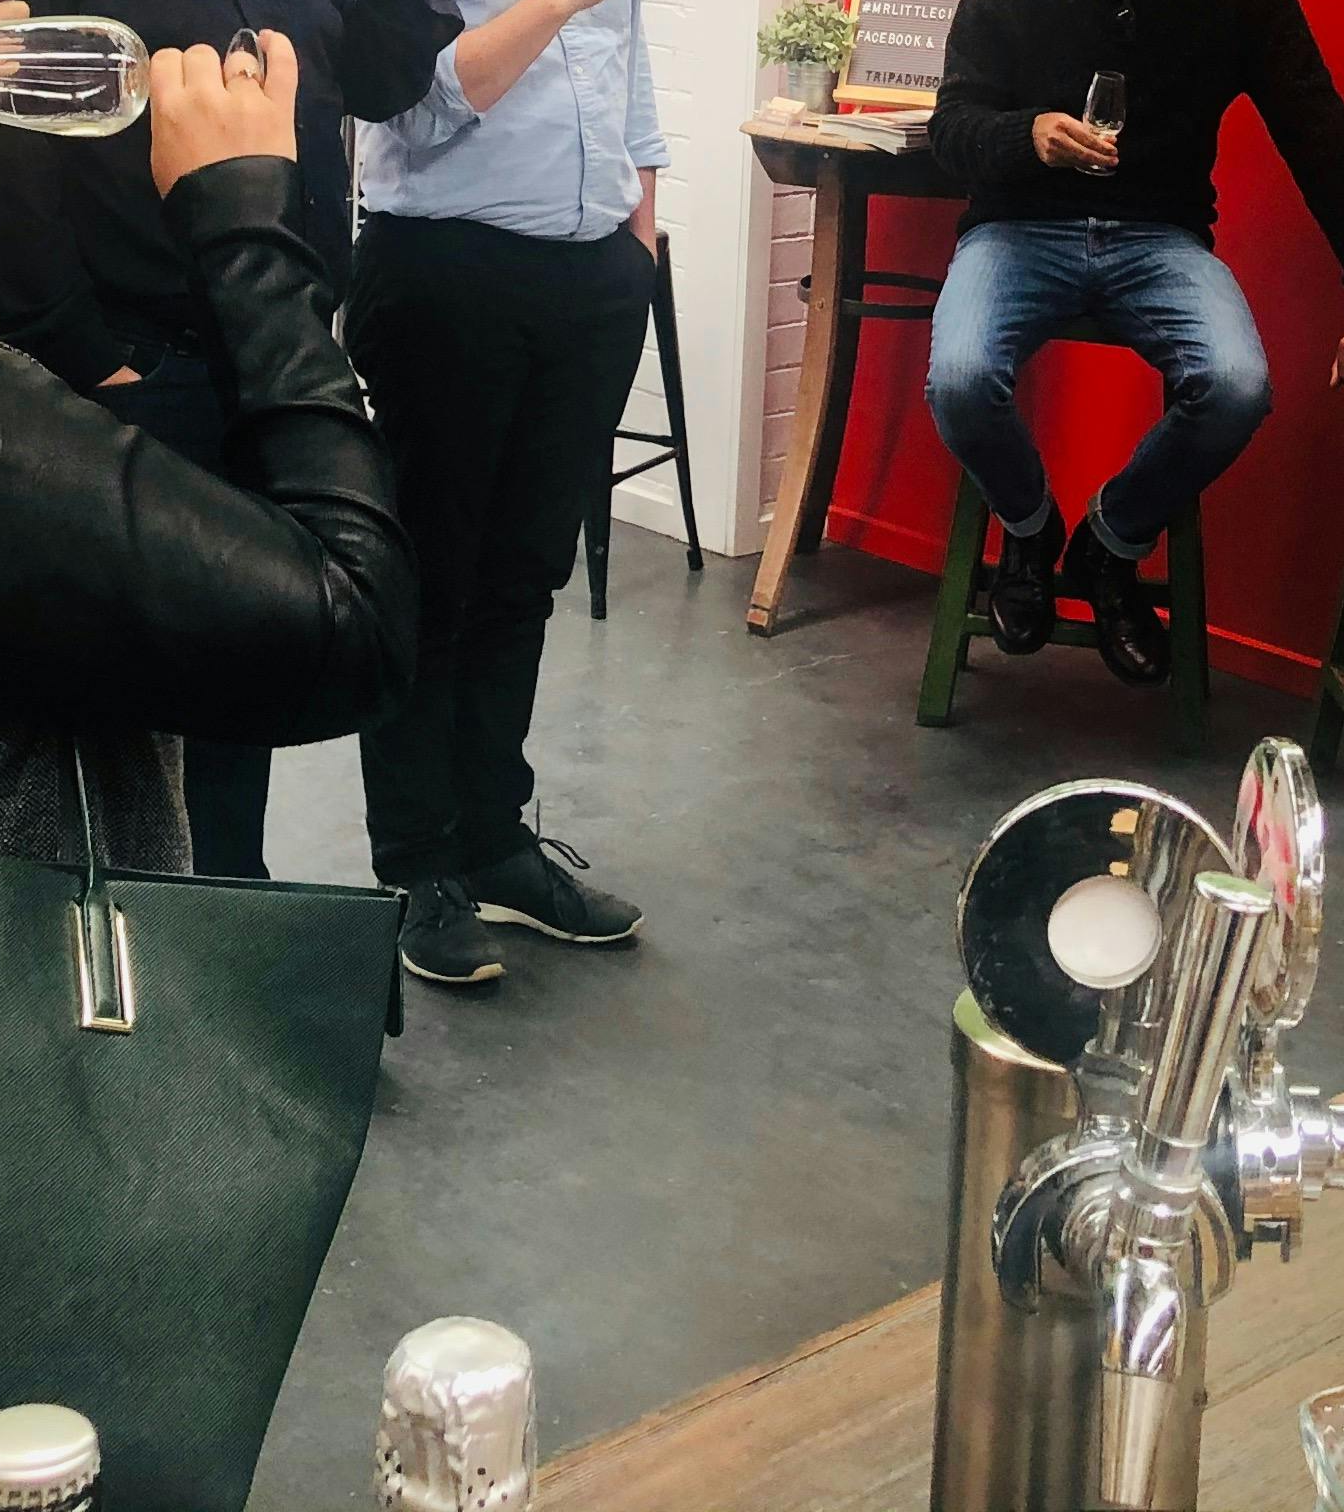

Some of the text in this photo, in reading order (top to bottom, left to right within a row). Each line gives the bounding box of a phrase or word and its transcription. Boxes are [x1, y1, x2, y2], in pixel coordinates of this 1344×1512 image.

[861, 1, 953, 20] #MRLITTLECI
[856, 30, 922, 47] FACEBOOK
[925, 37, 935, 49] &
[864, 69, 944, 89] TRIPADVISO
